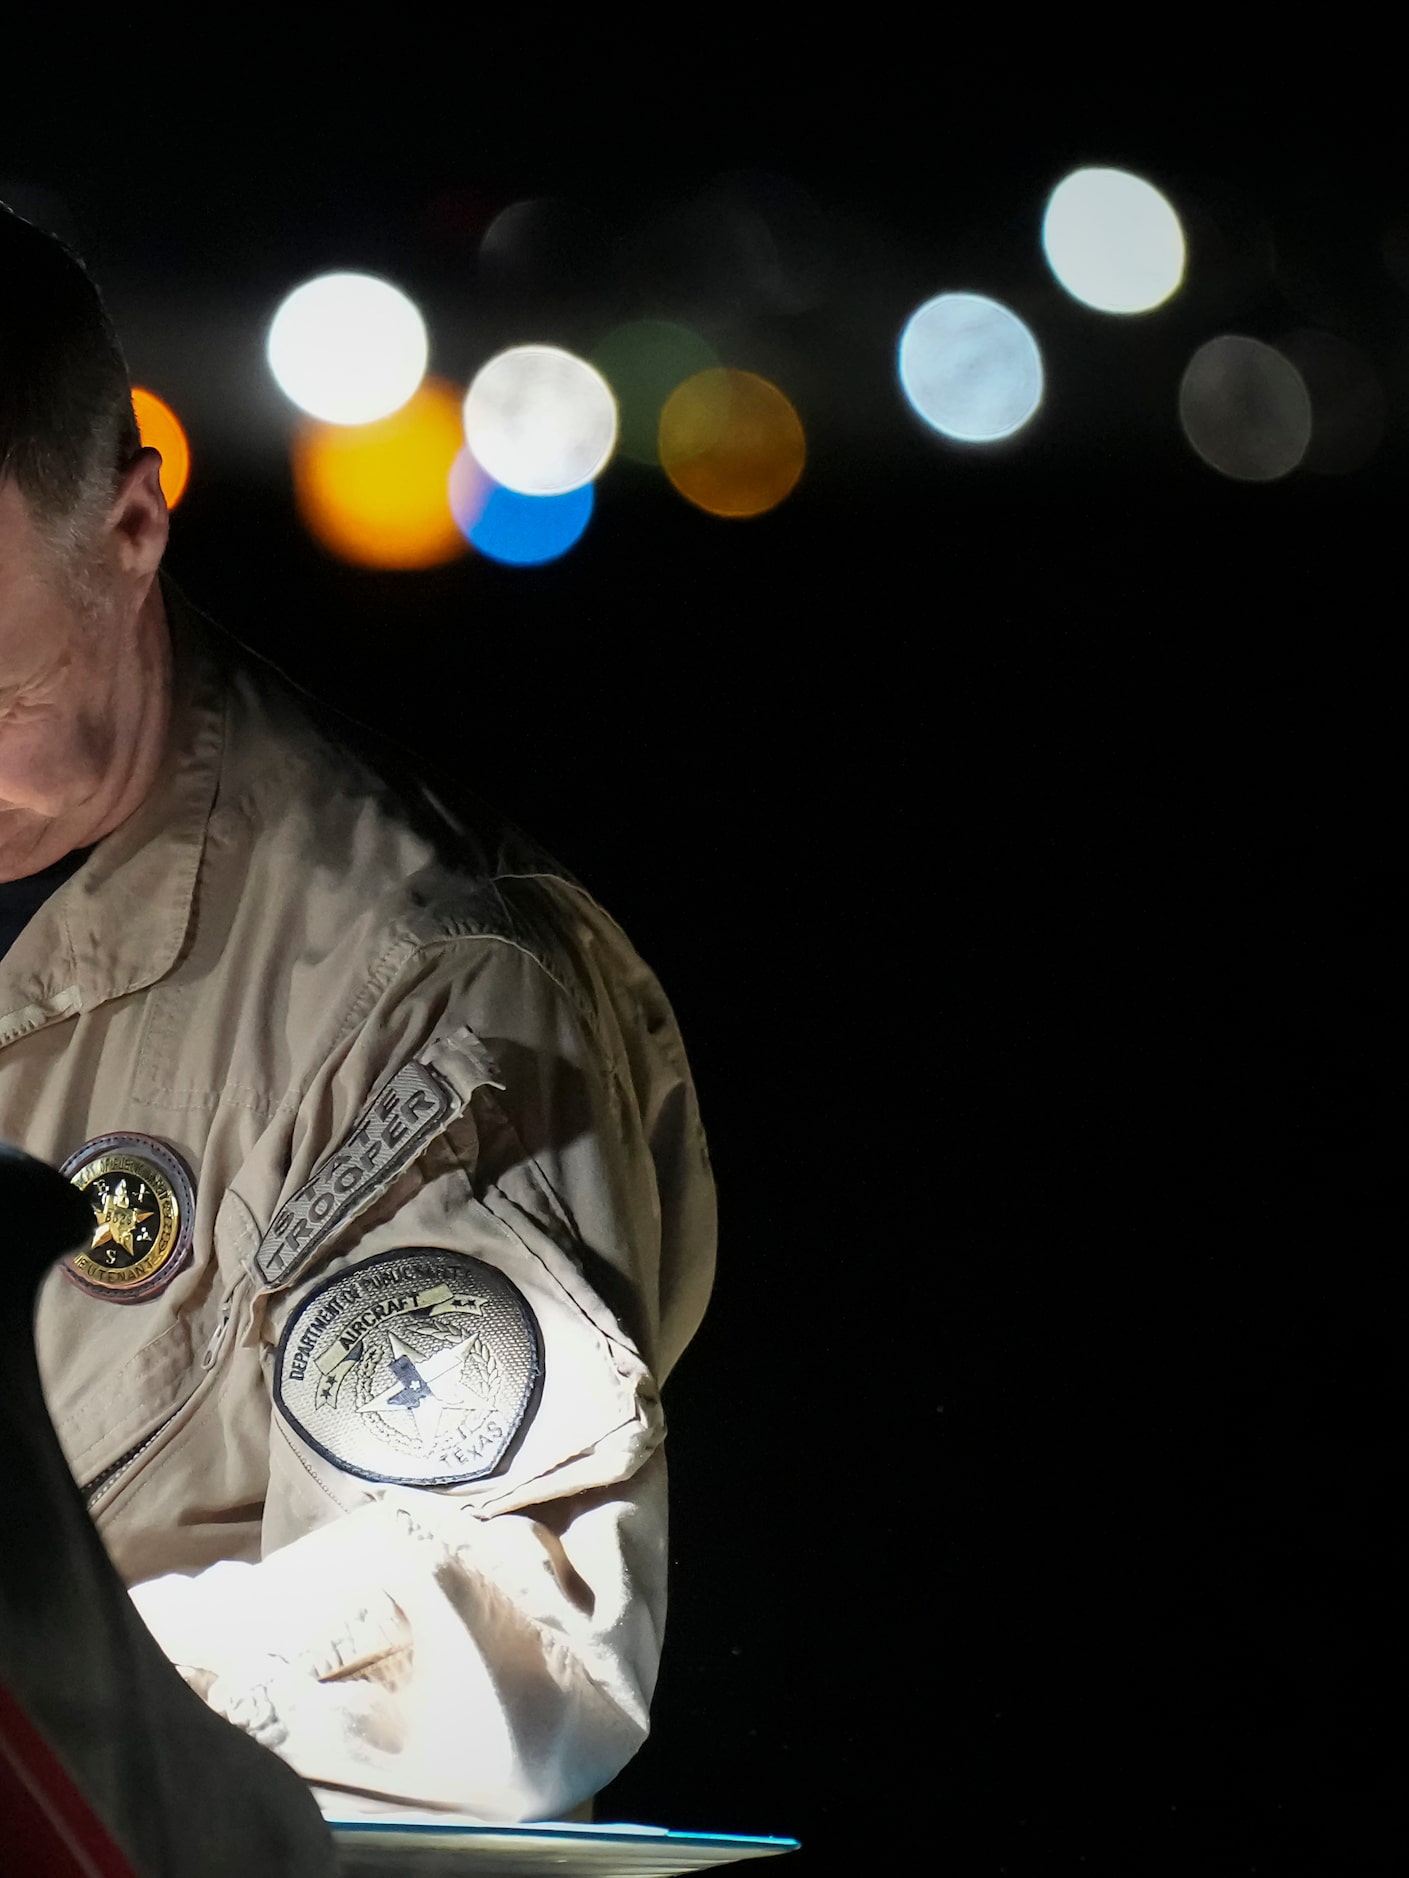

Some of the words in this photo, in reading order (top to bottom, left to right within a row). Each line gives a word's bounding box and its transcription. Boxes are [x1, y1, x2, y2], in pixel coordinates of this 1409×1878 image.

[266, 1090, 435, 1271] TROOPER
[289, 1296, 344, 1381] DEPARTMENT
[340, 1285, 363, 1304] OF
[338, 1292, 419, 1350] AIRCRAFT
[439, 1421, 503, 1468] TEXAS
